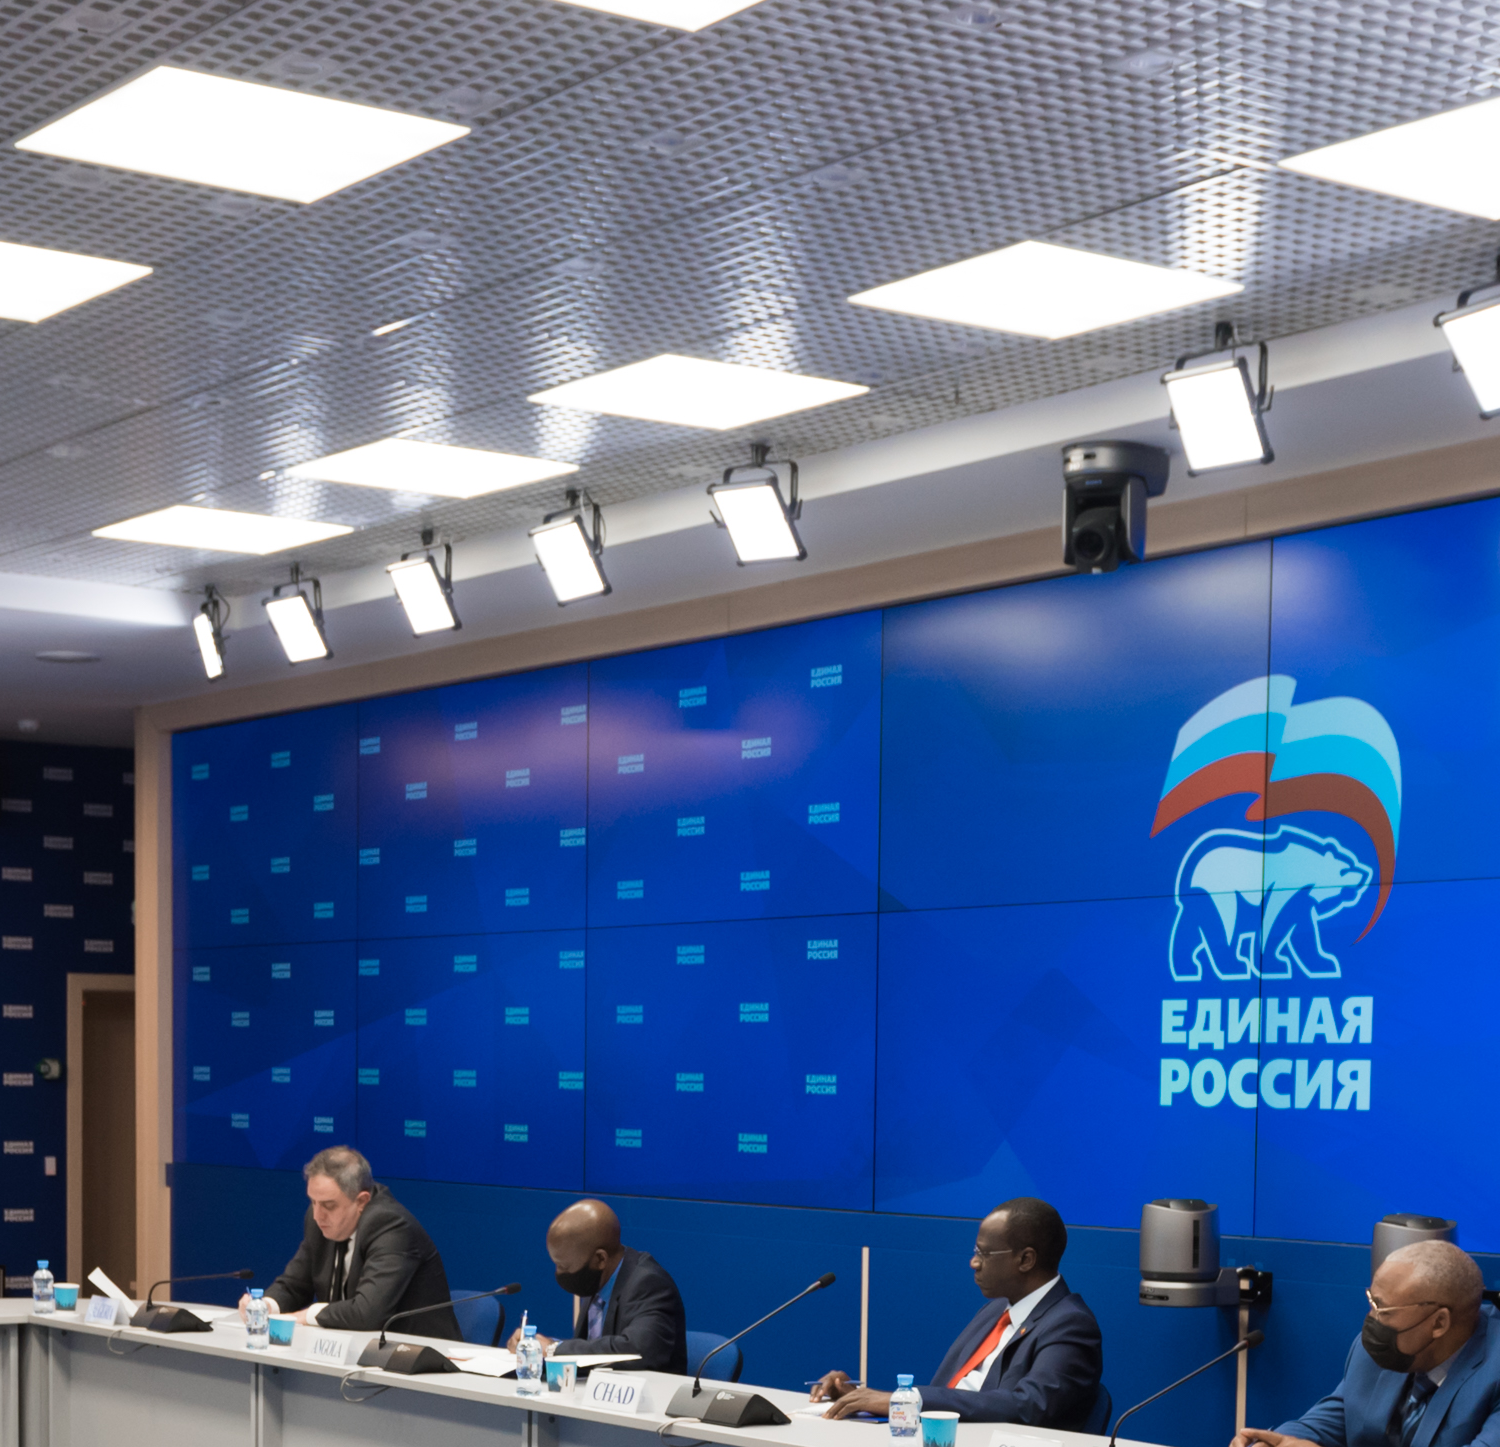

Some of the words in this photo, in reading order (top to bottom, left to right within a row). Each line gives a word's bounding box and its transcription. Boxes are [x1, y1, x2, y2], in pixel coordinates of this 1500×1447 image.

[1161, 996, 1374, 1050] ЕДИНАЯ
[1160, 1058, 1372, 1111] РОССИЯ
[593, 1382, 635, 1405] CHAD
